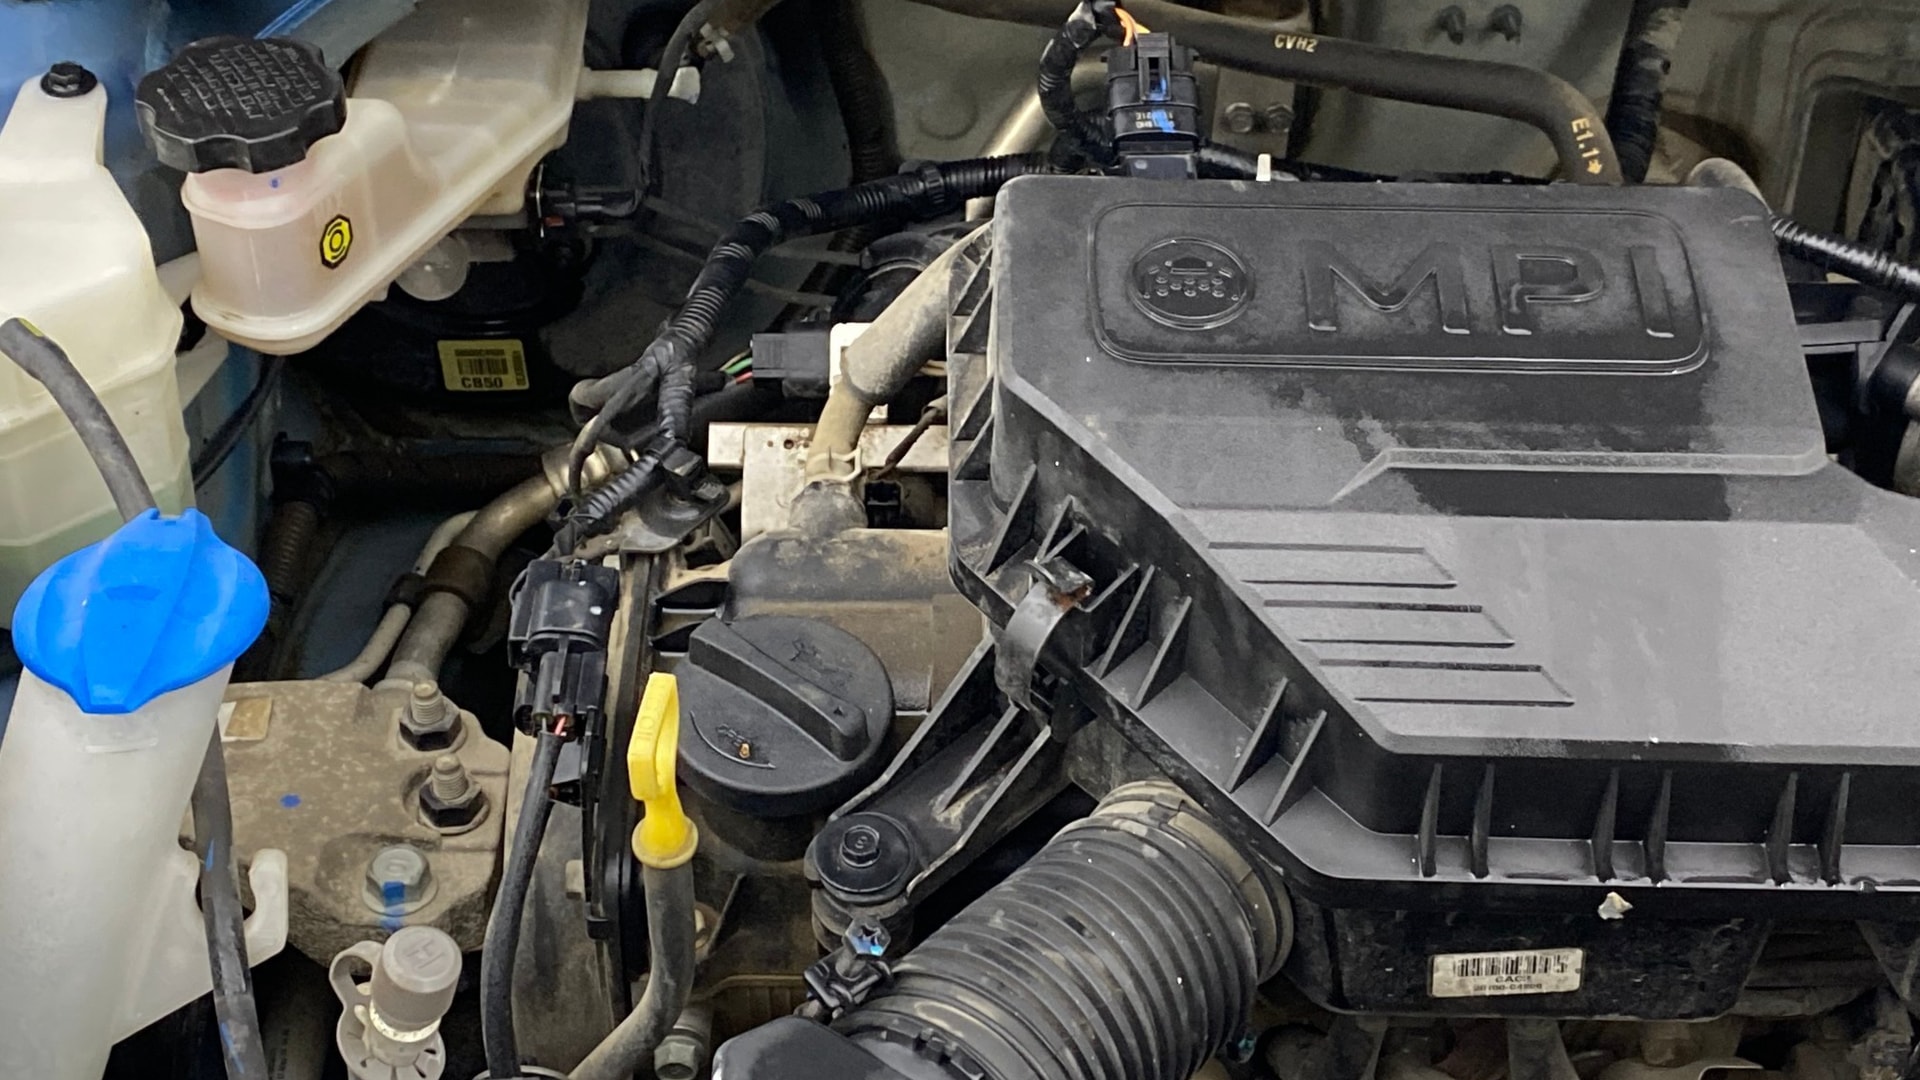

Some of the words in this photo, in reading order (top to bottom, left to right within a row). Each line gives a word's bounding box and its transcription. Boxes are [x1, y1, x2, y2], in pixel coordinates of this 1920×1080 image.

[1274, 34, 1318, 53] CVH2
[1572, 118, 1600, 158] E1.1
[1299, 239, 1675, 338] MPI
[461, 376, 503, 389] CB50
